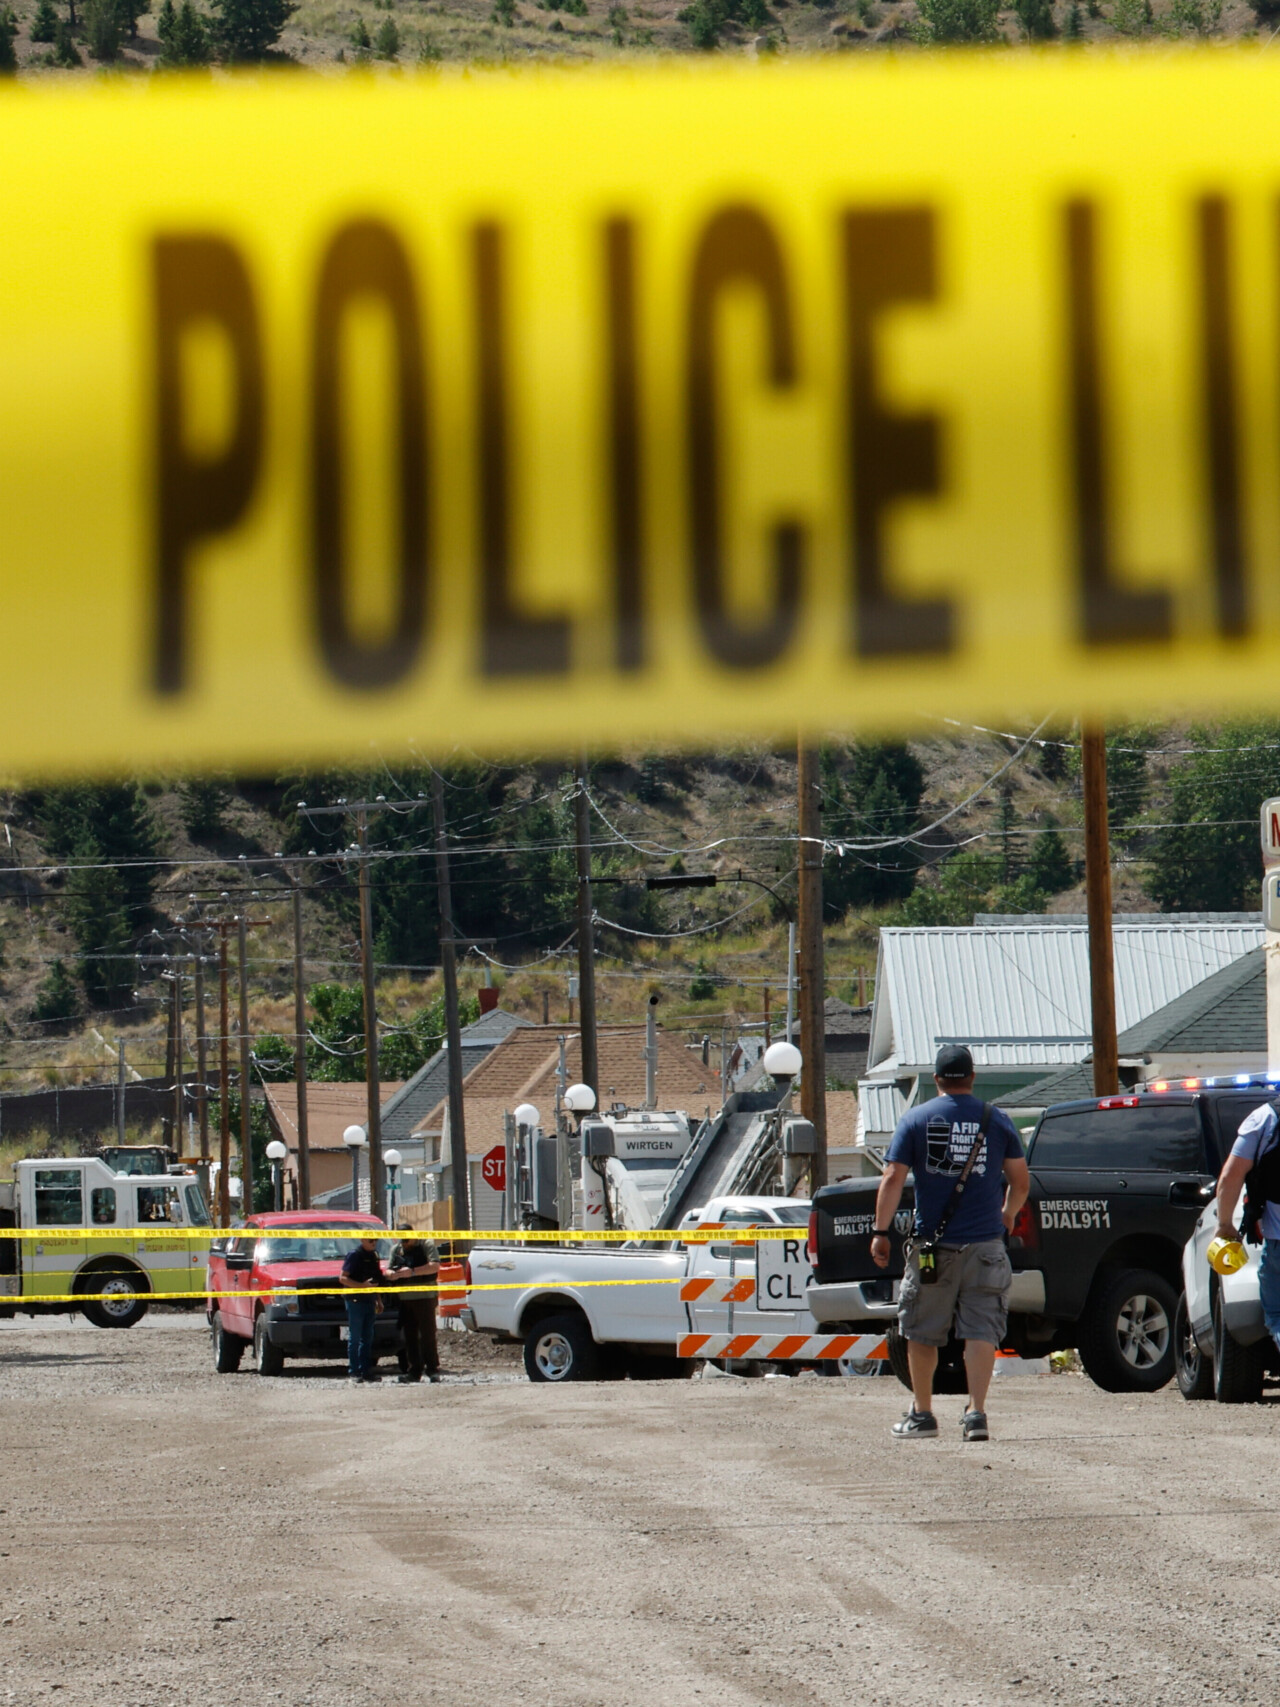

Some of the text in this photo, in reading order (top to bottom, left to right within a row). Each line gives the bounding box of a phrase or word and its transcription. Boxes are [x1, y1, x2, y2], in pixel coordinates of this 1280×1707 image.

[146, 200, 960, 703] POLICE
[961, 1122, 980, 1134] FIR
[626, 1141, 673, 1150] WIRTGEN
[952, 1154, 969, 1162] SINC
[1039, 1200, 1108, 1211] EMERGENCY
[834, 1214, 875, 1224] EMERGENCY
[1041, 1211, 1111, 1229] DIAL911
